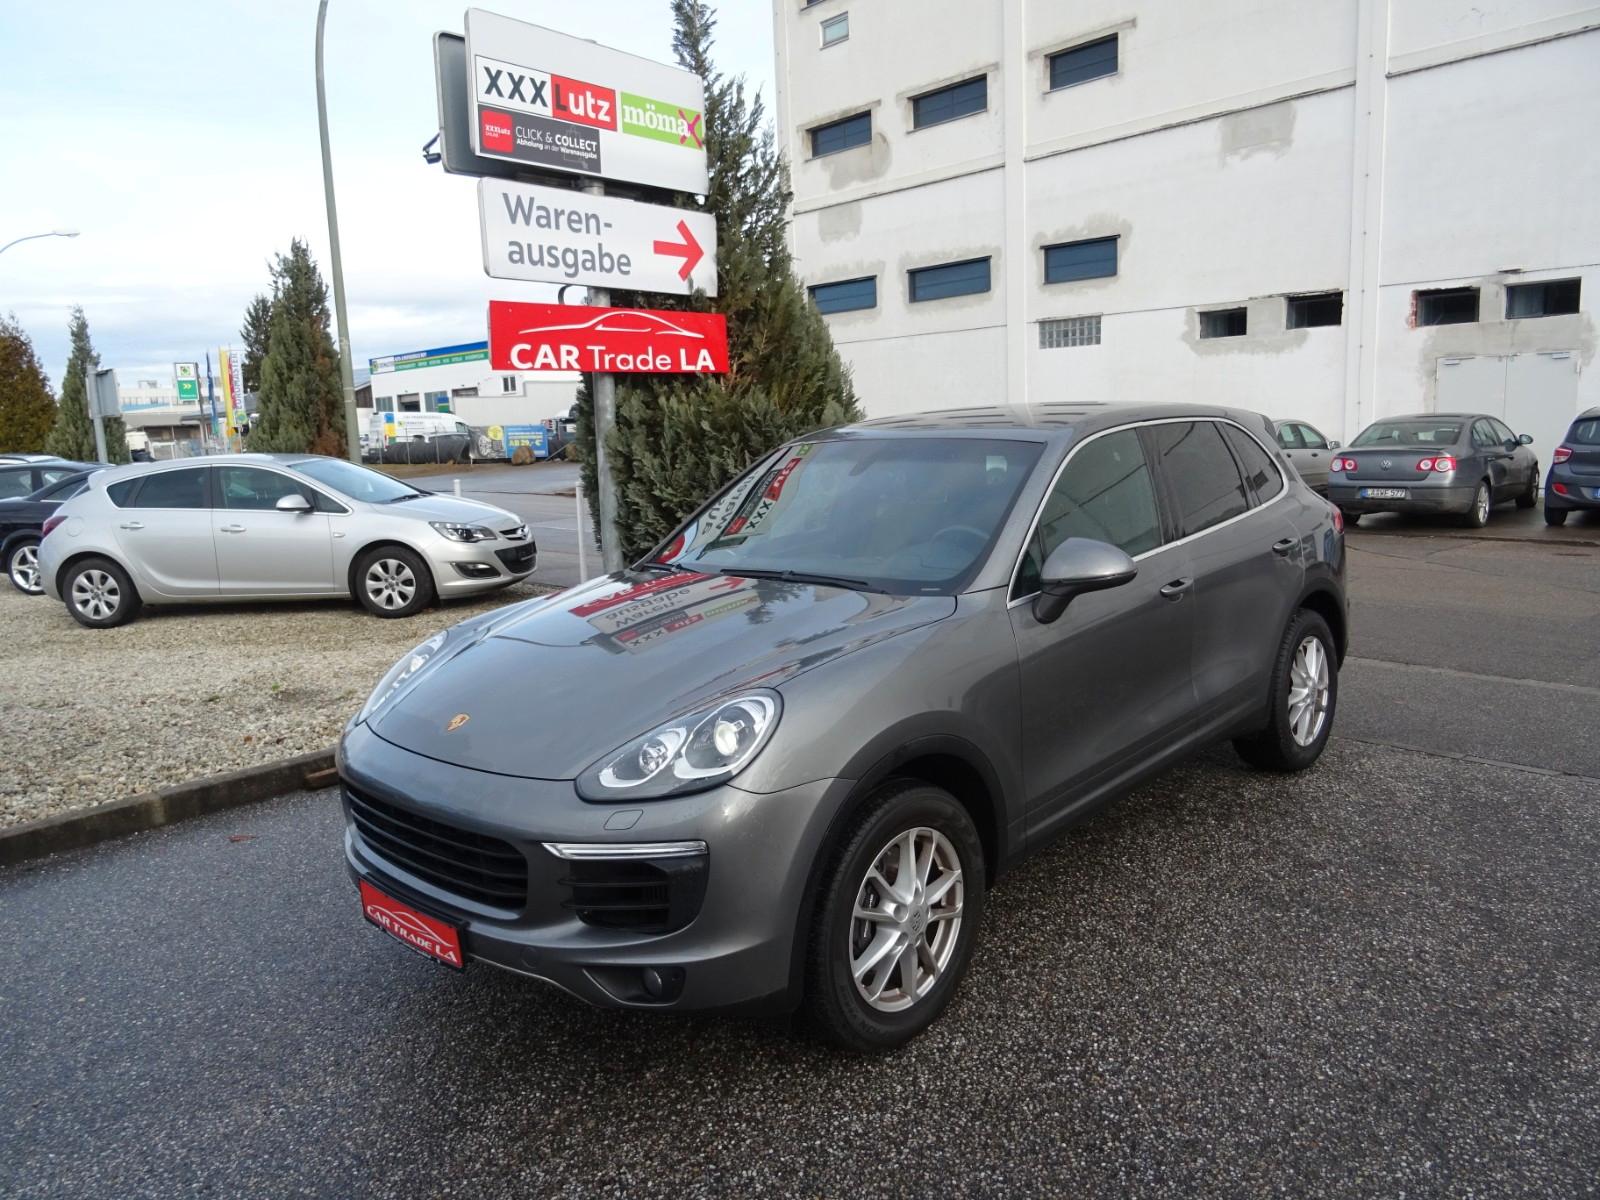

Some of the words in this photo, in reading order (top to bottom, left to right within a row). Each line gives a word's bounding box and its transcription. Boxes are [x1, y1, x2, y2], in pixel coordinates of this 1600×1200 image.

[515, 126, 543, 142] CLICK
[545, 132, 553, 143] &
[555, 134, 598, 152] COLLECT
[502, 192, 613, 236] Waren-
[508, 240, 632, 279] ausgabe
[510, 343, 581, 370] CAR
[586, 345, 672, 371] Trade
[680, 348, 716, 371] LA
[366, 905, 391, 928] CAR
[392, 921, 434, 951] TRADE
[435, 944, 458, 963] LA
